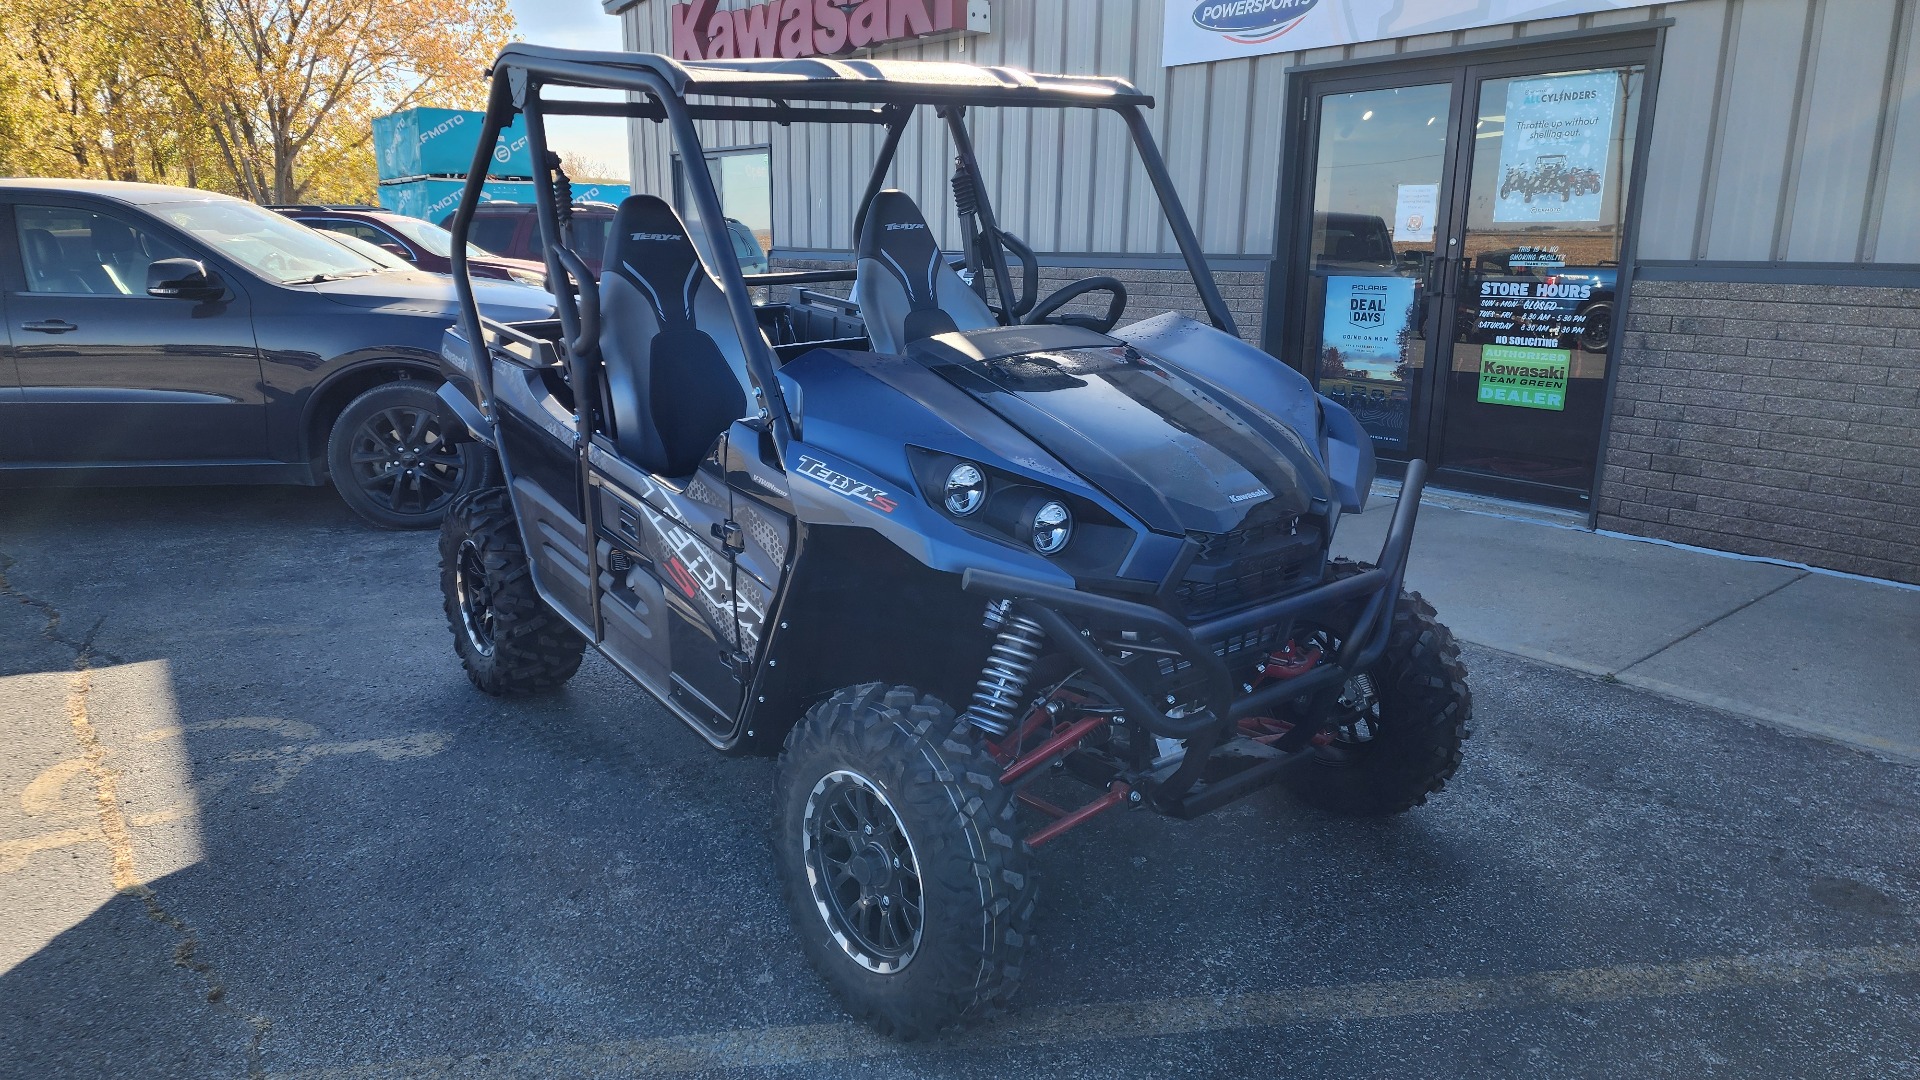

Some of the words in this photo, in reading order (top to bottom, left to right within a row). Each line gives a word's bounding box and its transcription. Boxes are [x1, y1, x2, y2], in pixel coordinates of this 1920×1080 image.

[1517, 120, 1549, 130] Throttle
[1551, 120, 1562, 129] up
[1564, 117, 1600, 127] without
[1529, 129, 1562, 139] shelling
[1564, 128, 1581, 137] out.
[1549, 245, 1559, 253] NO
[1481, 281, 1529, 296] STORE
[1537, 283, 1591, 298] HOURS
[1351, 298, 1385, 311] DEAL
[1523, 300, 1557, 310] CLOSED
[1353, 312, 1380, 322] DAYS
[1479, 310, 1495, 318] TUES
[1500, 311, 1513, 319] FRI
[1573, 315, 1586, 323] PM
[1478, 321, 1514, 330] SATURDAY
[1535, 324, 1550, 332] AM
[1495, 335, 1508, 344] NO
[1508, 336, 1559, 348] SOLICITING
[1485, 349, 1567, 362] AUTHORIZED
[1483, 361, 1565, 380] Kawasaki
[1483, 375, 1516, 385] TEAM
[1520, 379, 1563, 389] GREEN
[1480, 387, 1561, 406] DEALER
